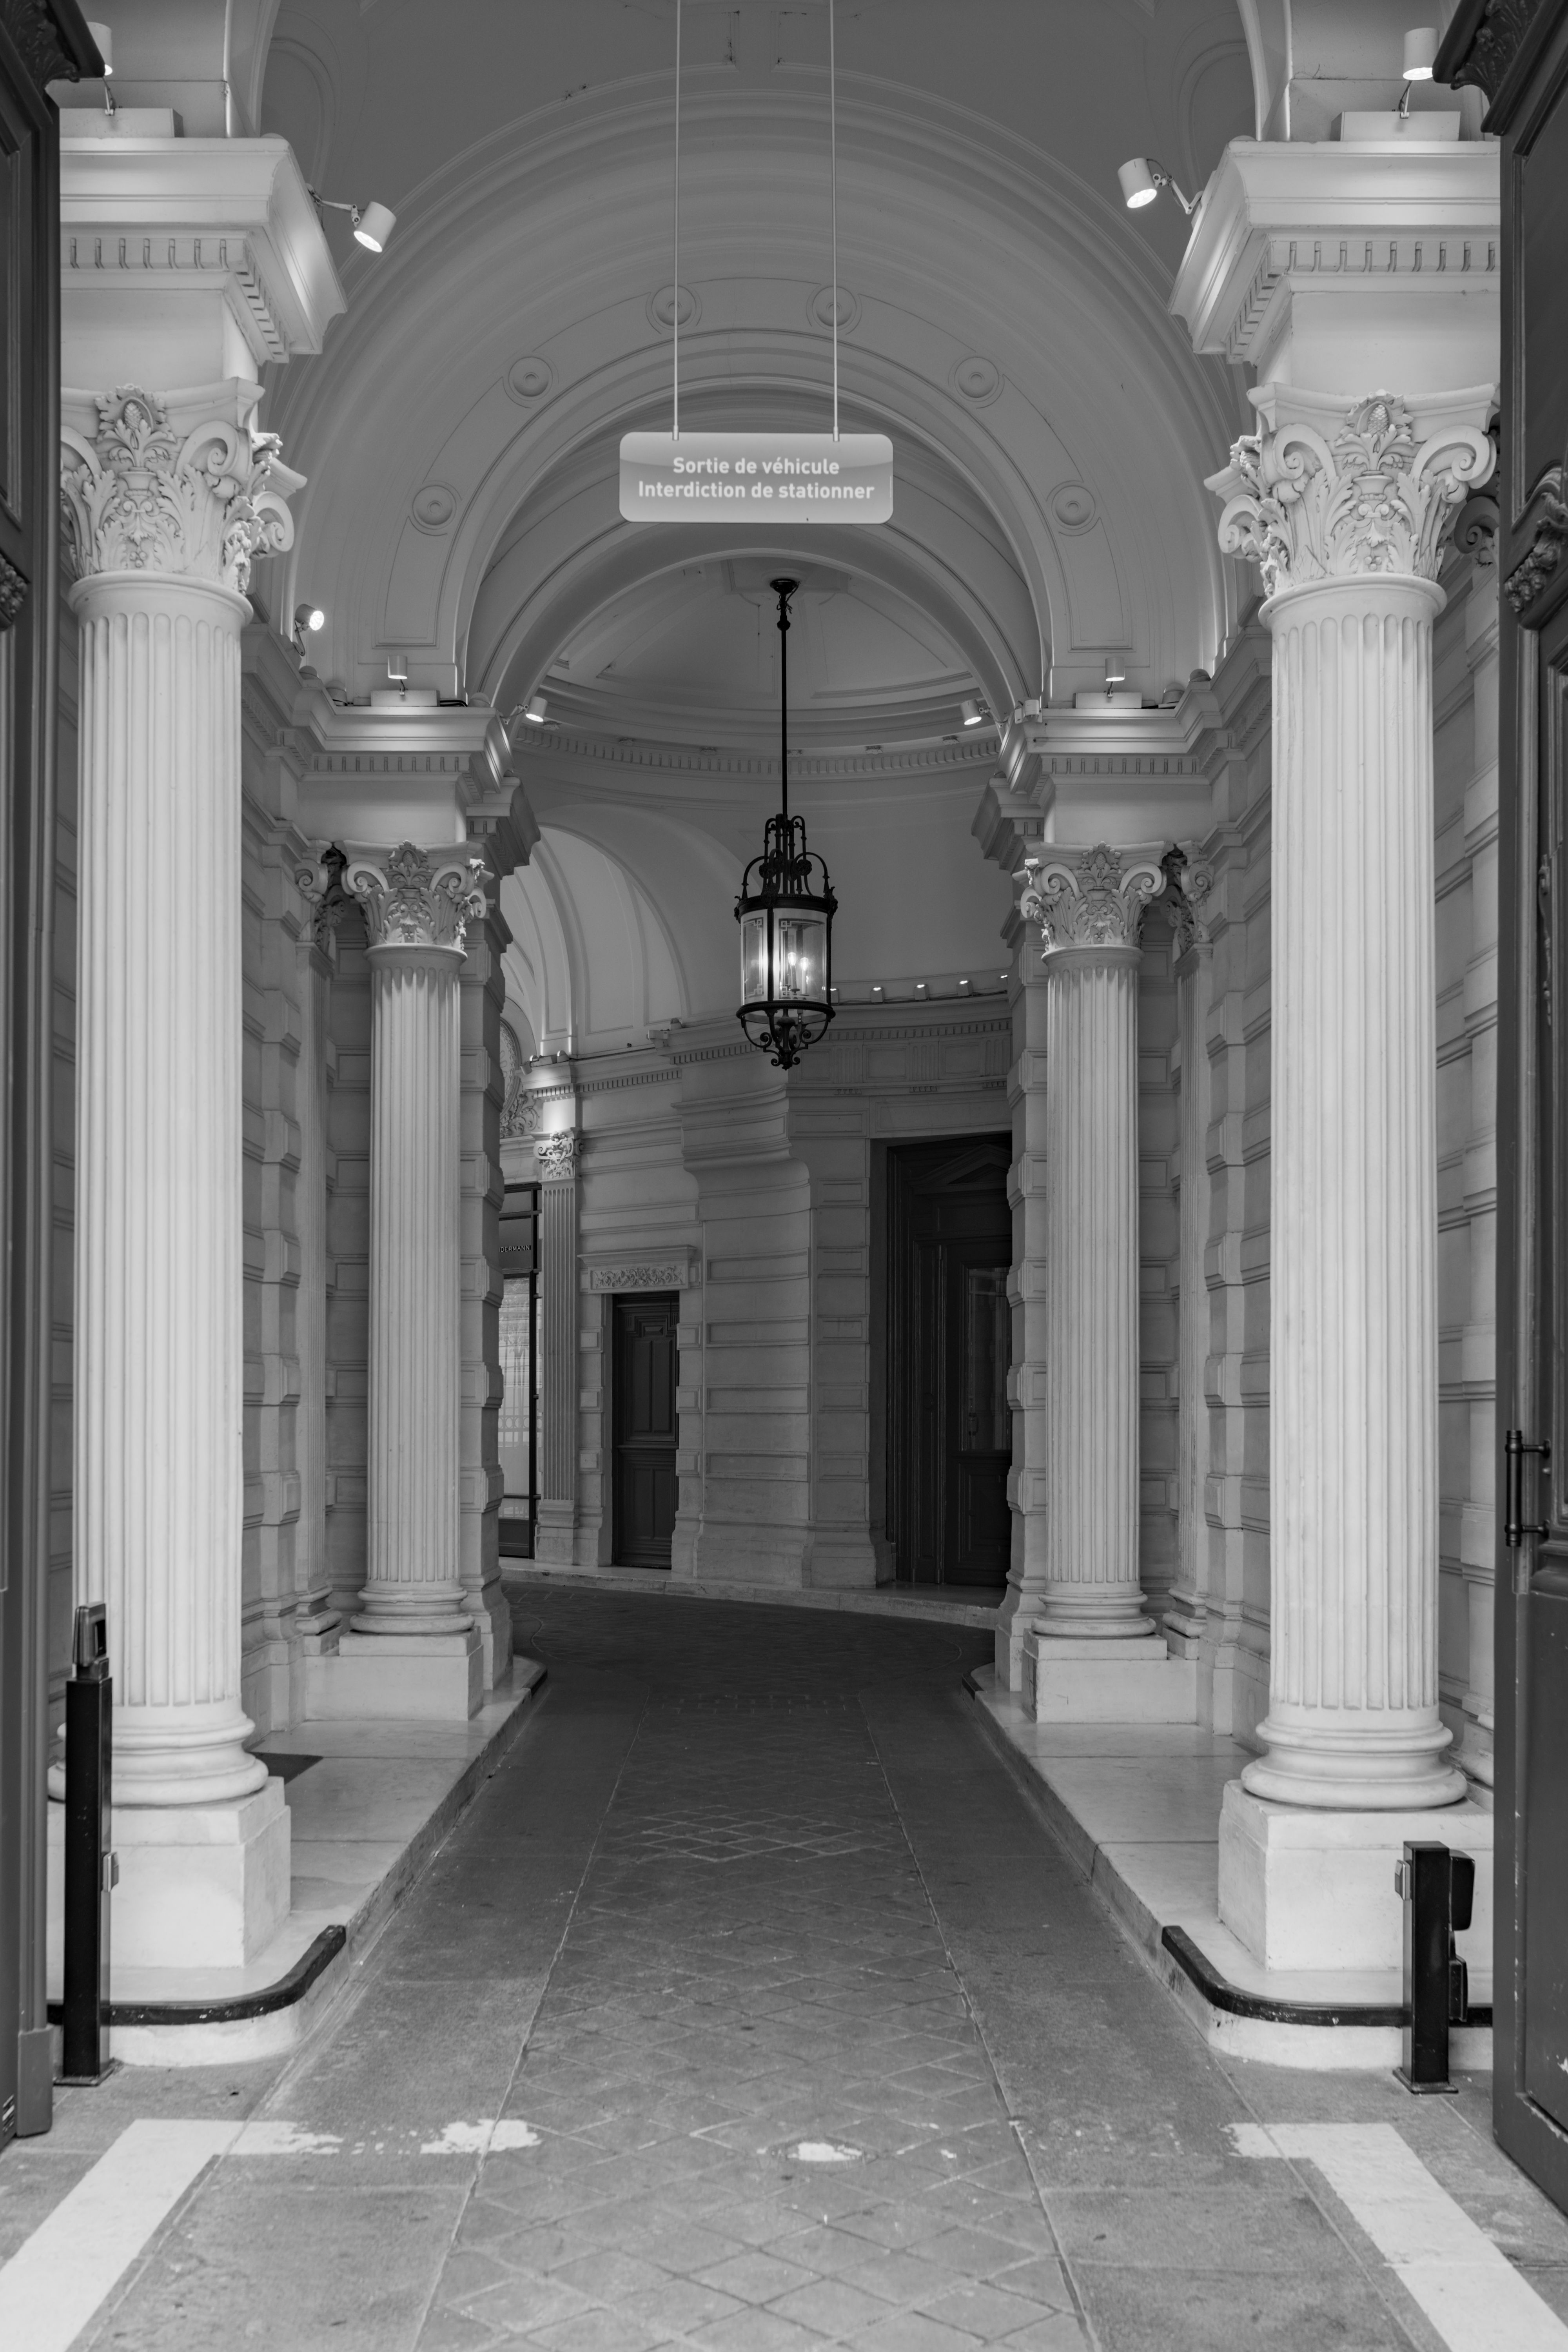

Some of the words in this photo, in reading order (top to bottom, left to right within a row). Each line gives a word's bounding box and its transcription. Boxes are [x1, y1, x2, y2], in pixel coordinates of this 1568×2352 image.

[673, 457, 729, 474] Sortie
[735, 458, 757, 474] de
[762, 457, 839, 474] véhicule
[639, 481, 745, 497] Interdiction
[751, 482, 773, 498] de
[779, 483, 875, 499] stationner
